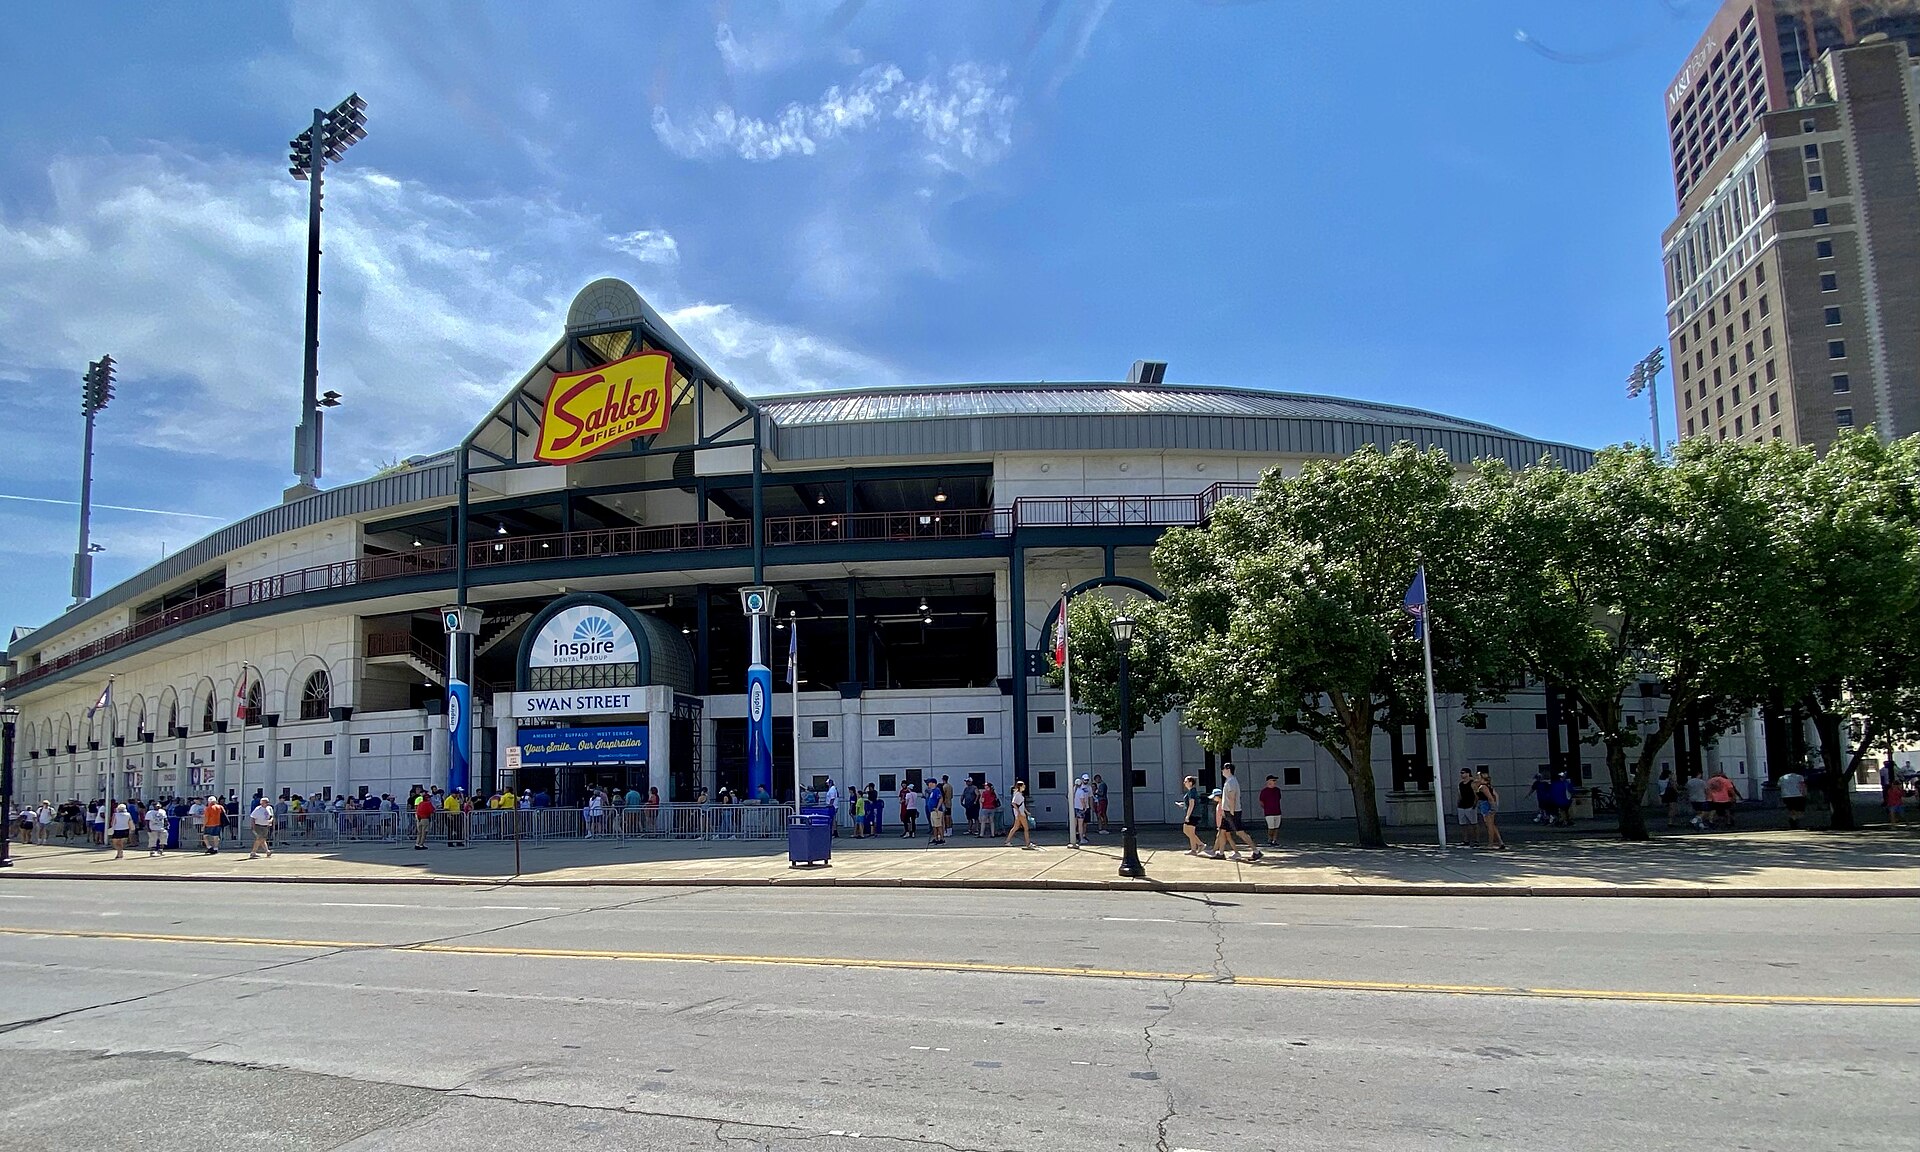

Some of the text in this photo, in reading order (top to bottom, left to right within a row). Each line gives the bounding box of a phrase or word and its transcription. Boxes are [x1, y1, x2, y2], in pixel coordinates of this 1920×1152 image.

[1669, 36, 1717, 110] M&T Bank
[550, 374, 660, 452] Sahlen
[595, 420, 635, 442] FIELD
[553, 637, 615, 659] inspire
[527, 694, 631, 711] SWAN STREET
[524, 744, 545, 756] Your
[578, 740, 594, 751] Our
[595, 738, 642, 750] Inspiration
